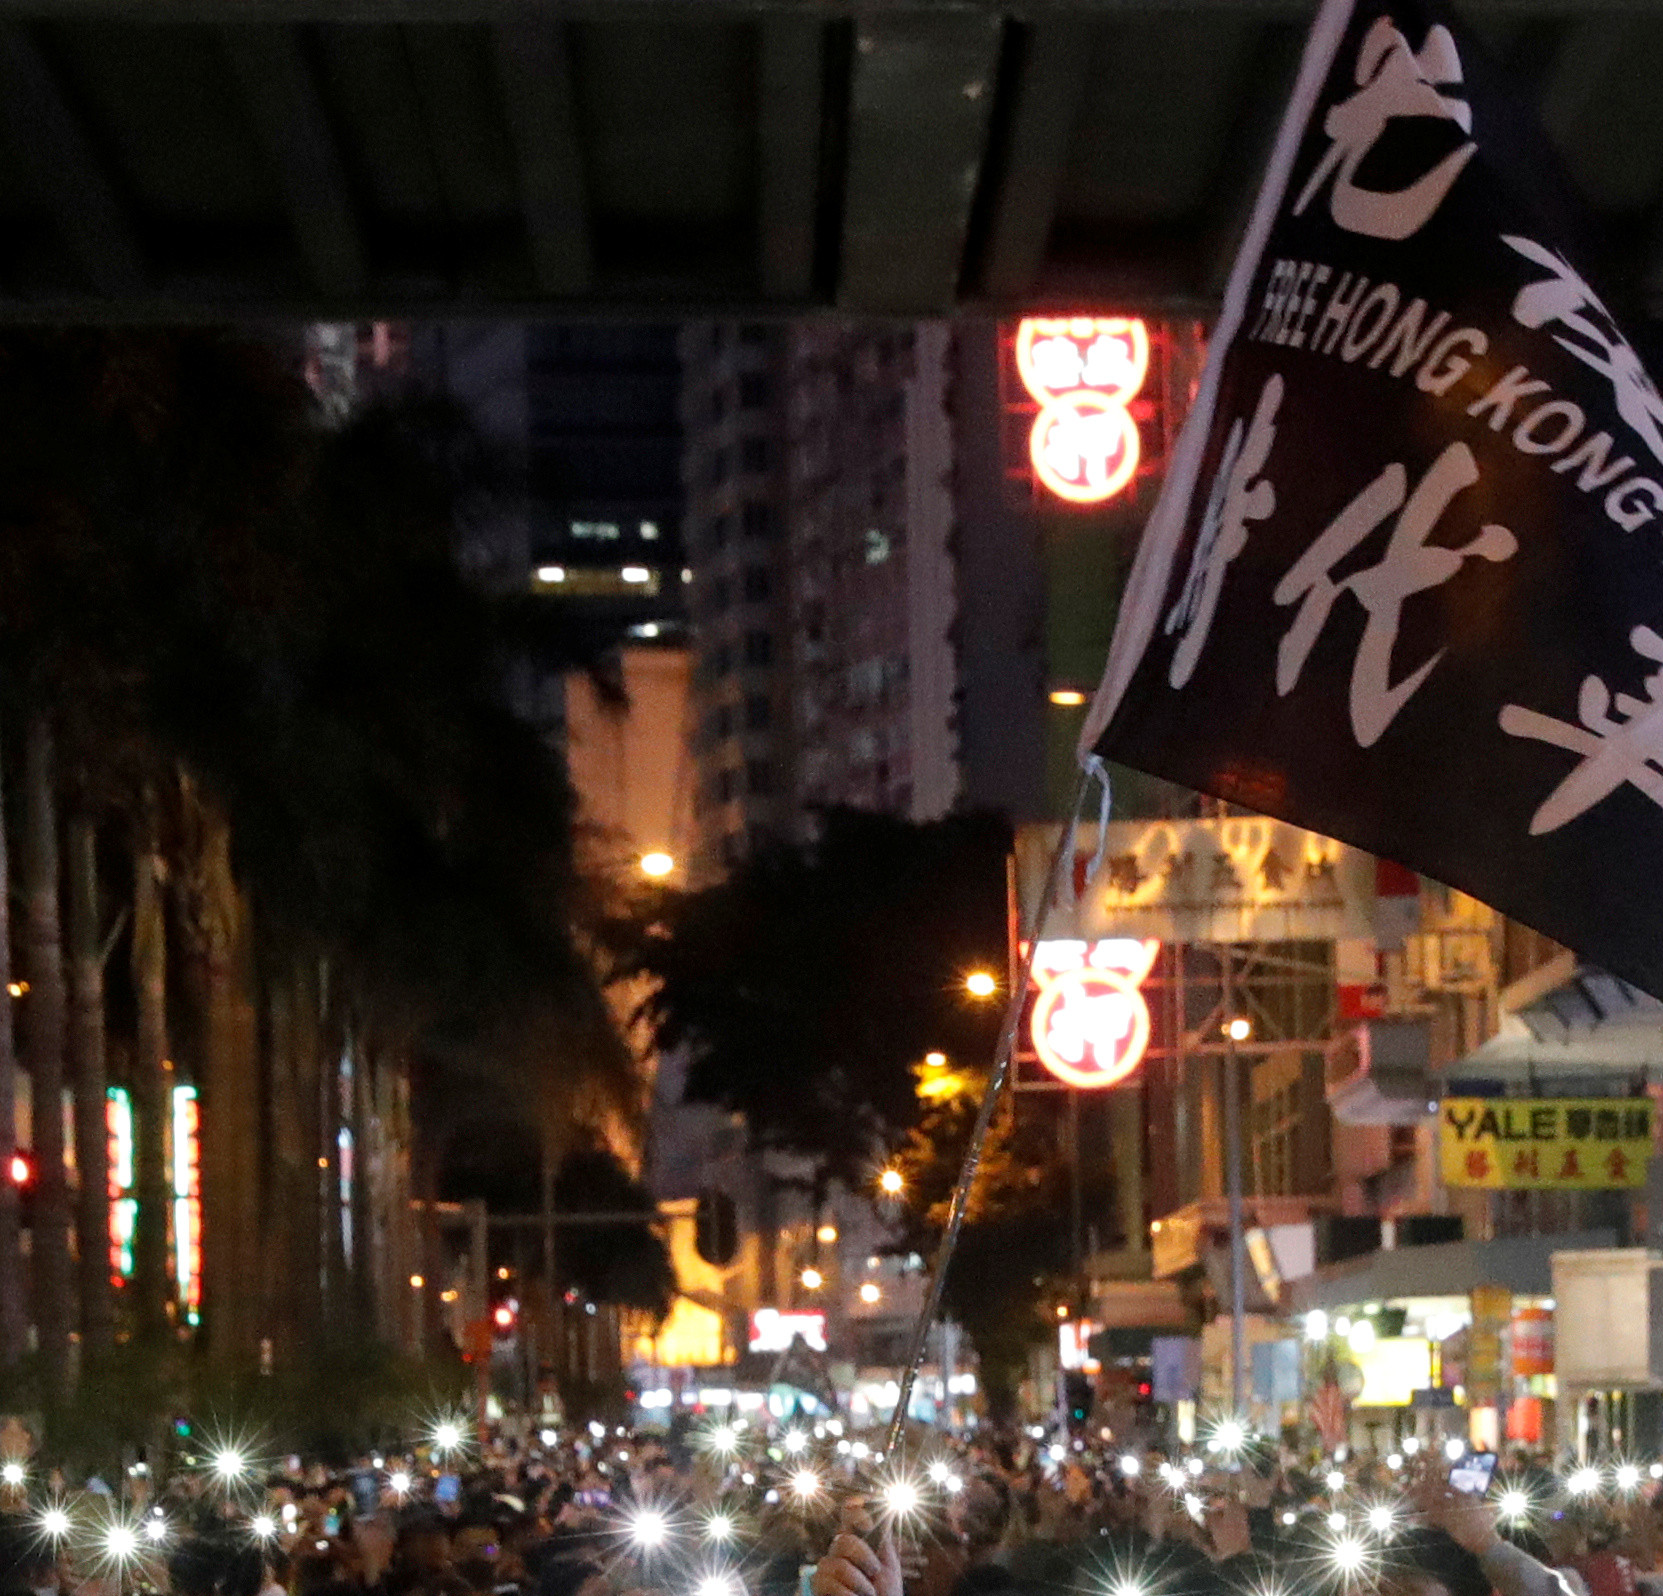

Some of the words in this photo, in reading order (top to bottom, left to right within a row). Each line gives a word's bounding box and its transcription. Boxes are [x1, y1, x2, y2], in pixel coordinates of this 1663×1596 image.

[1248, 259, 1321, 347] FREE
[1313, 271, 1490, 389] HONG
[1445, 1106, 1557, 1140] YALE
